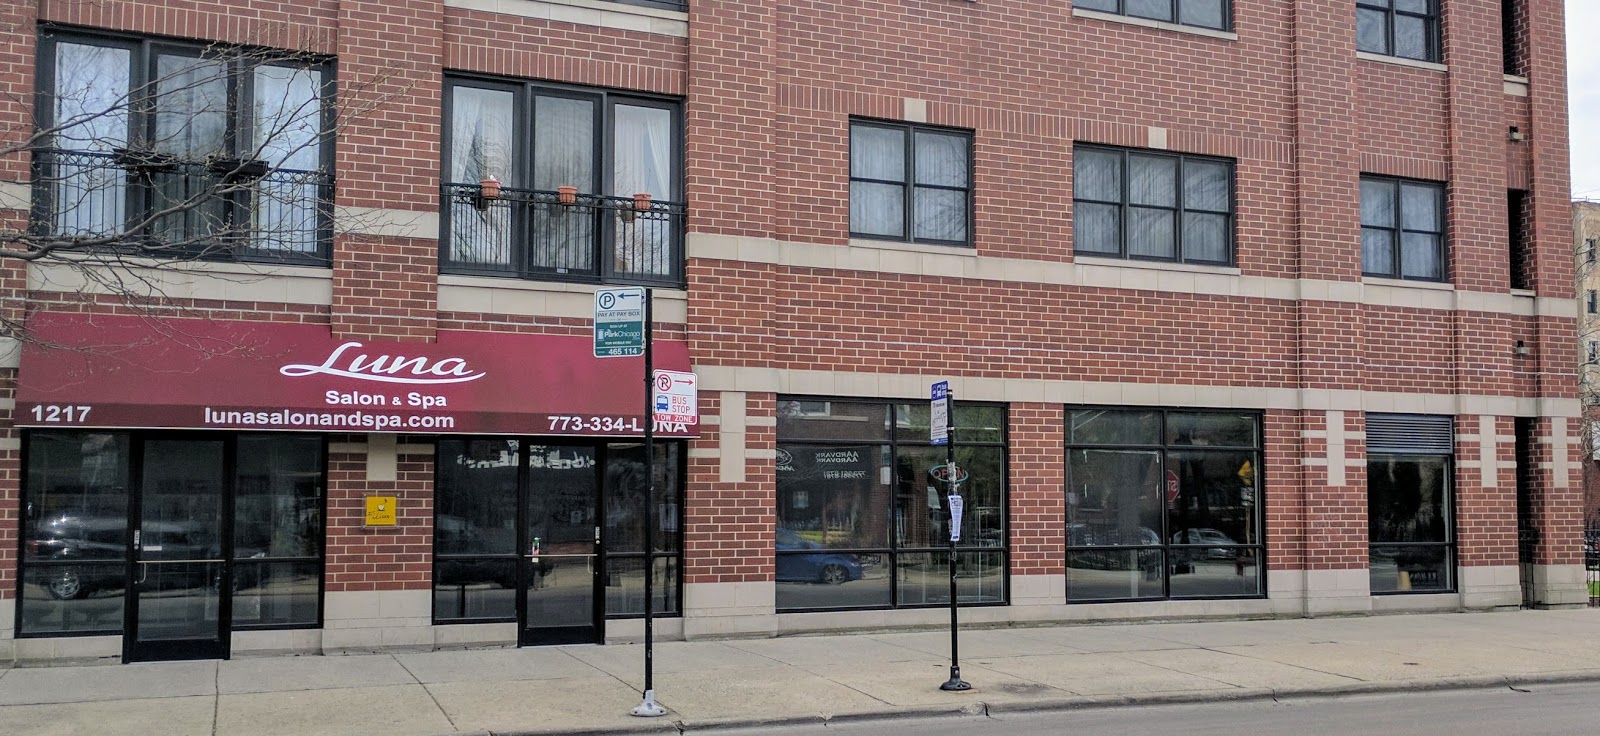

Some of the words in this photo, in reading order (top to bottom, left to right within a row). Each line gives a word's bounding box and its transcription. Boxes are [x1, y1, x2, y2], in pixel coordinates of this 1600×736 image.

[608, 348, 622, 356] 465
[624, 347, 638, 355] 114
[280, 342, 487, 384] Luna
[325, 390, 386, 406] Salon
[391, 396, 402, 406] &
[407, 392, 448, 409] Spa
[672, 396, 687, 405] BUS
[31, 405, 92, 422] 1217
[672, 405, 691, 414] STOP
[204, 407, 455, 430] lunasalonandspa.com
[674, 415, 693, 423] ZONE
[932, 469, 965, 479] OPN
